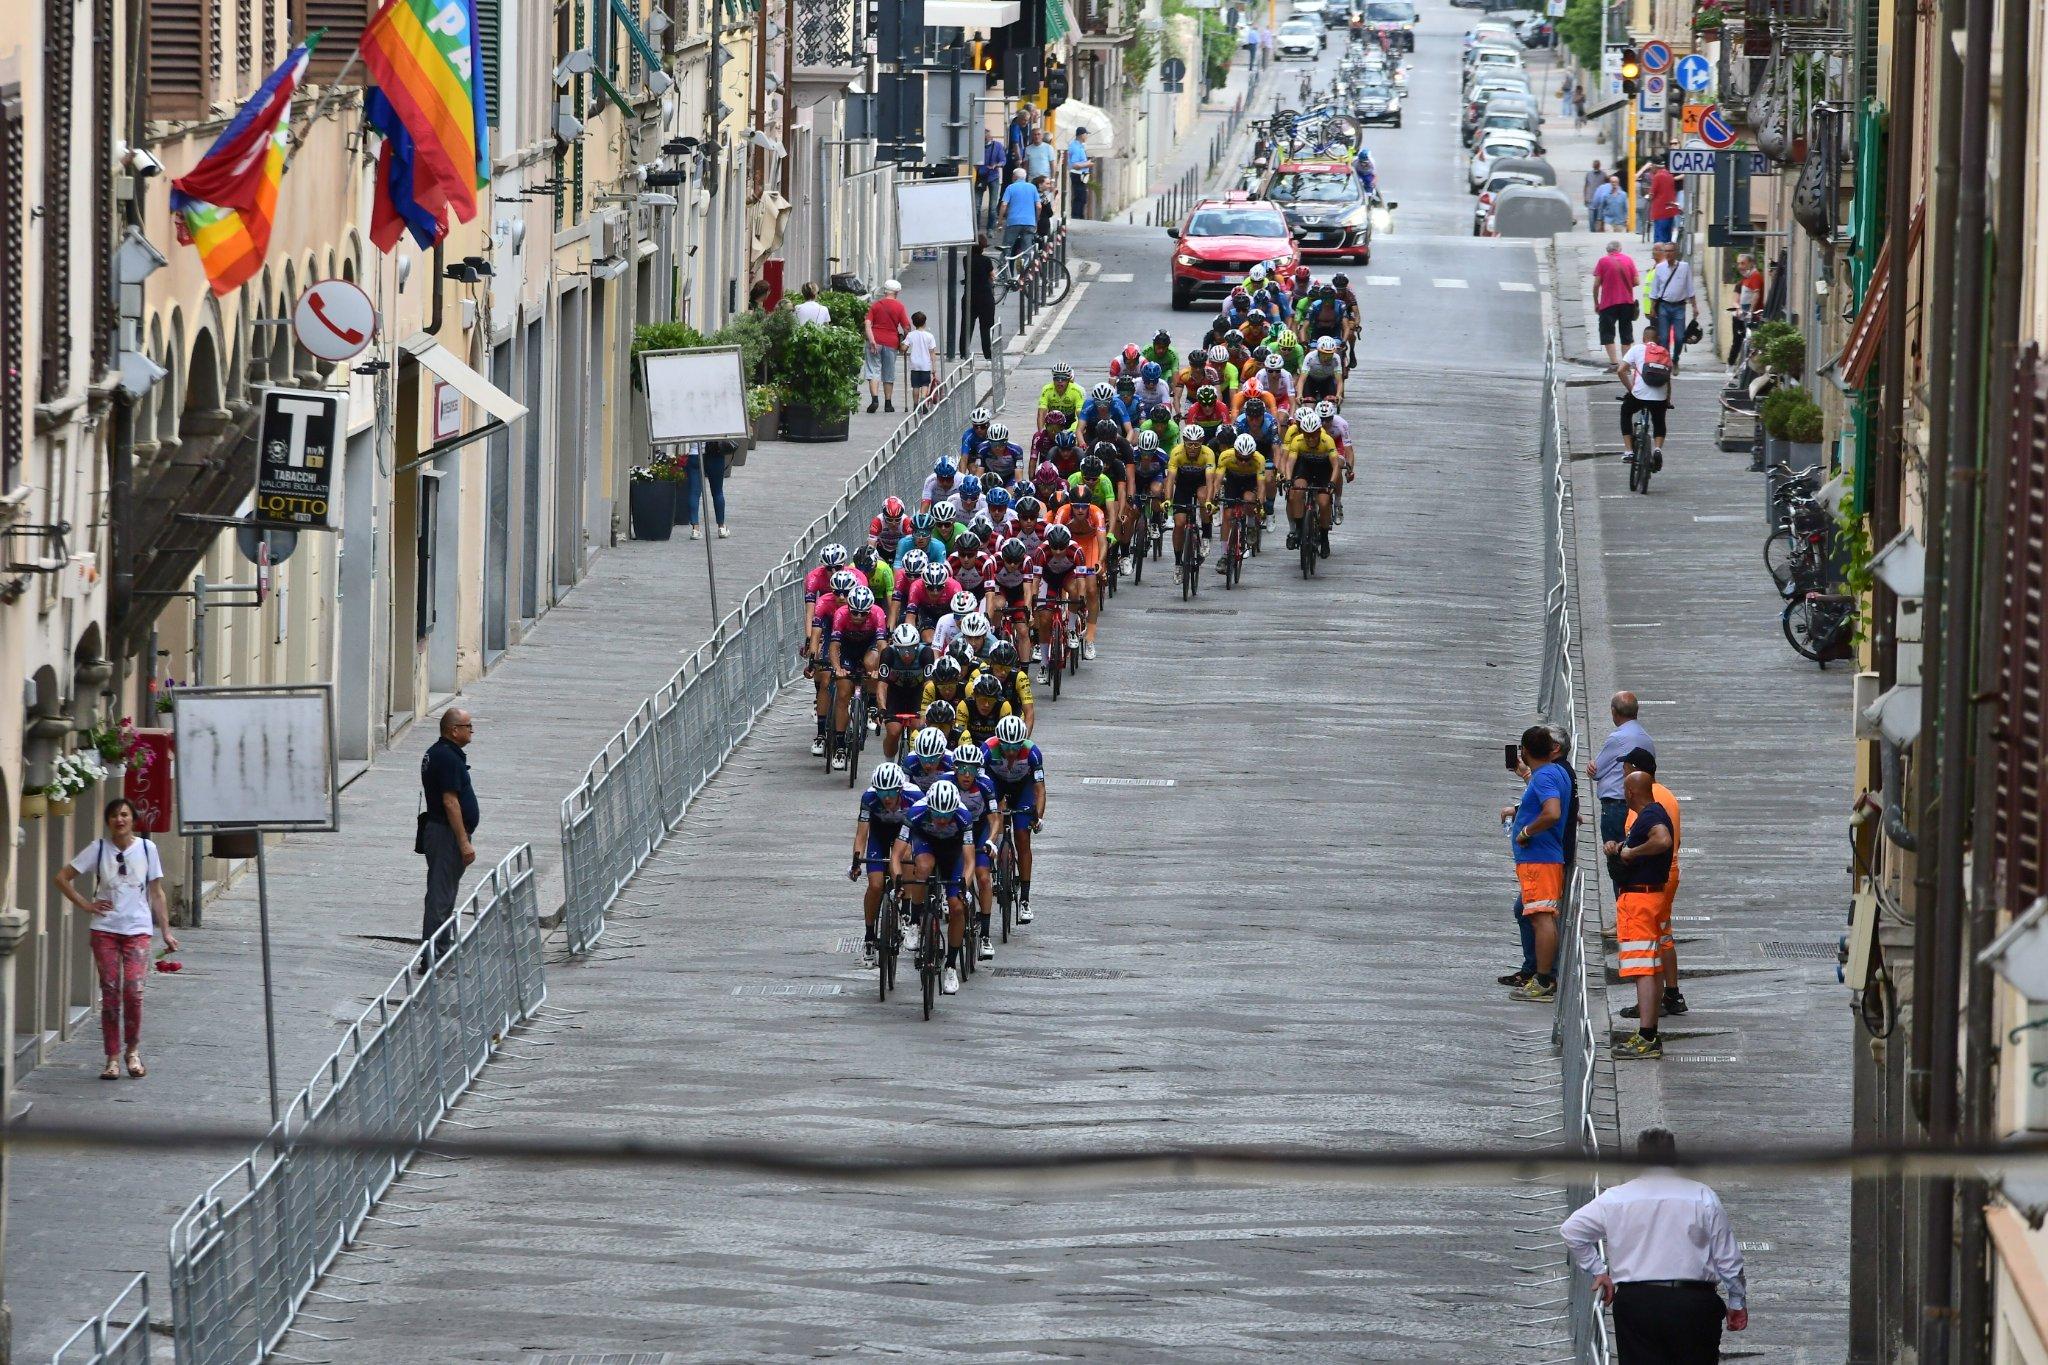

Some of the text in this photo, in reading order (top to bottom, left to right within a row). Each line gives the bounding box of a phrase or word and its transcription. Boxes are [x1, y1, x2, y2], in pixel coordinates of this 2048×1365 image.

[278, 398, 324, 467] T
[275, 470, 316, 483] TABACCHI
[261, 480, 328, 493] VALORI BOLLATI
[259, 496, 326, 514] LOTTO
